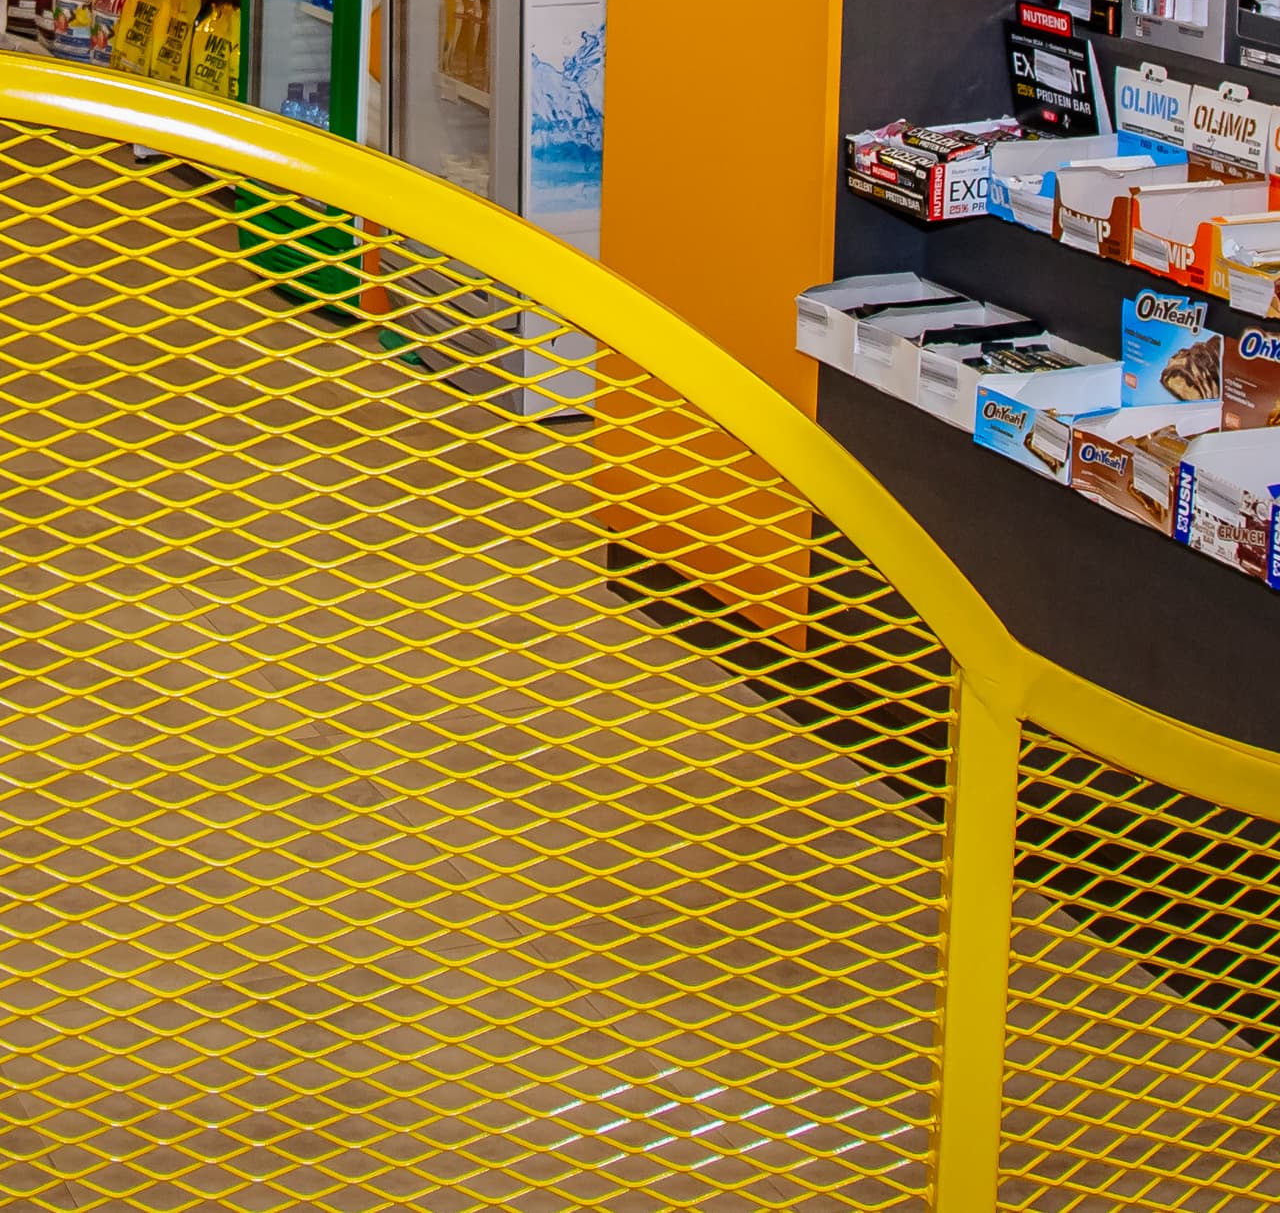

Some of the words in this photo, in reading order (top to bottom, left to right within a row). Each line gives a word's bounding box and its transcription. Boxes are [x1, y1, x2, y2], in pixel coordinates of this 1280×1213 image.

[1022, 8, 1068, 32] NUTREND
[1036, 88, 1072, 109] PROTEIN
[1072, 98, 1092, 115] BAR
[1121, 85, 1179, 122] OLIMP
[1193, 104, 1257, 143] OLIMP
[885, 190, 908, 206] PROTEIN
[933, 166, 944, 217] NUTREND
[1179, 473, 1193, 516] USN
[1218, 525, 1266, 547] CRUNCH
